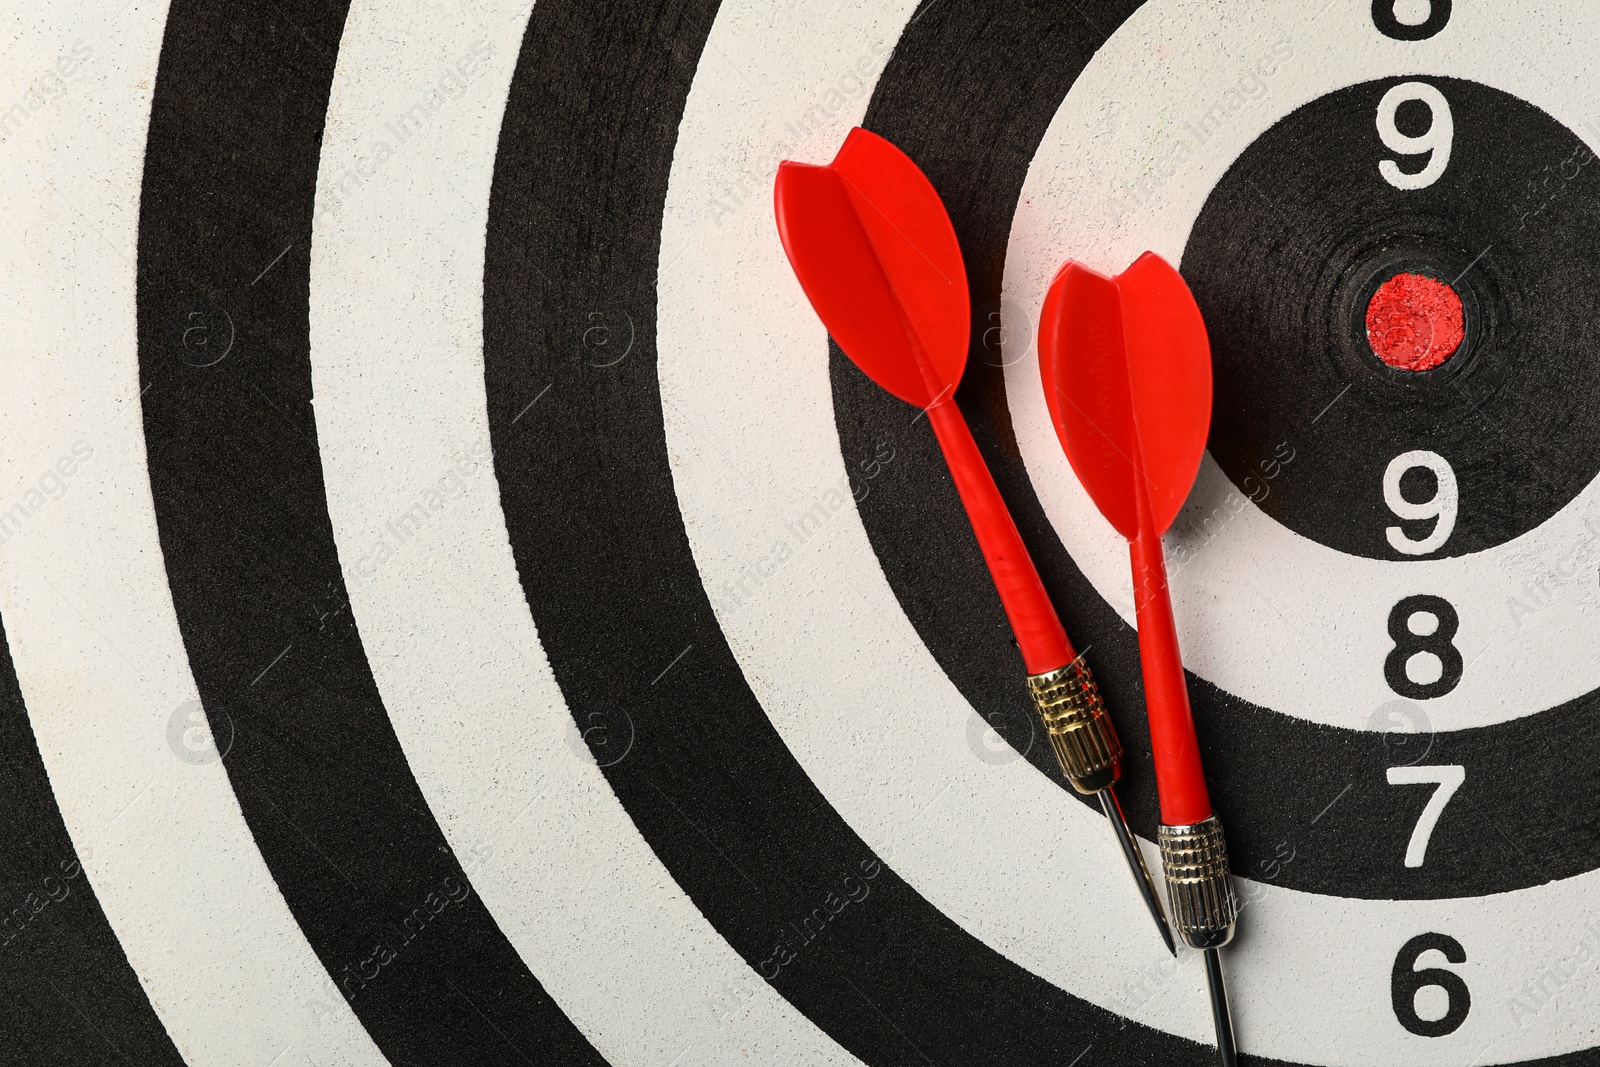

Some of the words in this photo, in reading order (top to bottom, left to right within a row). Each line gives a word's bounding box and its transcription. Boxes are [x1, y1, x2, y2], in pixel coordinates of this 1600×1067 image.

[1376, 82, 1454, 191] 9
[1383, 450, 1458, 556] 9
[1384, 594, 1463, 700] 8
[1386, 764, 1465, 868] 7
[1391, 932, 1471, 1037] 6
